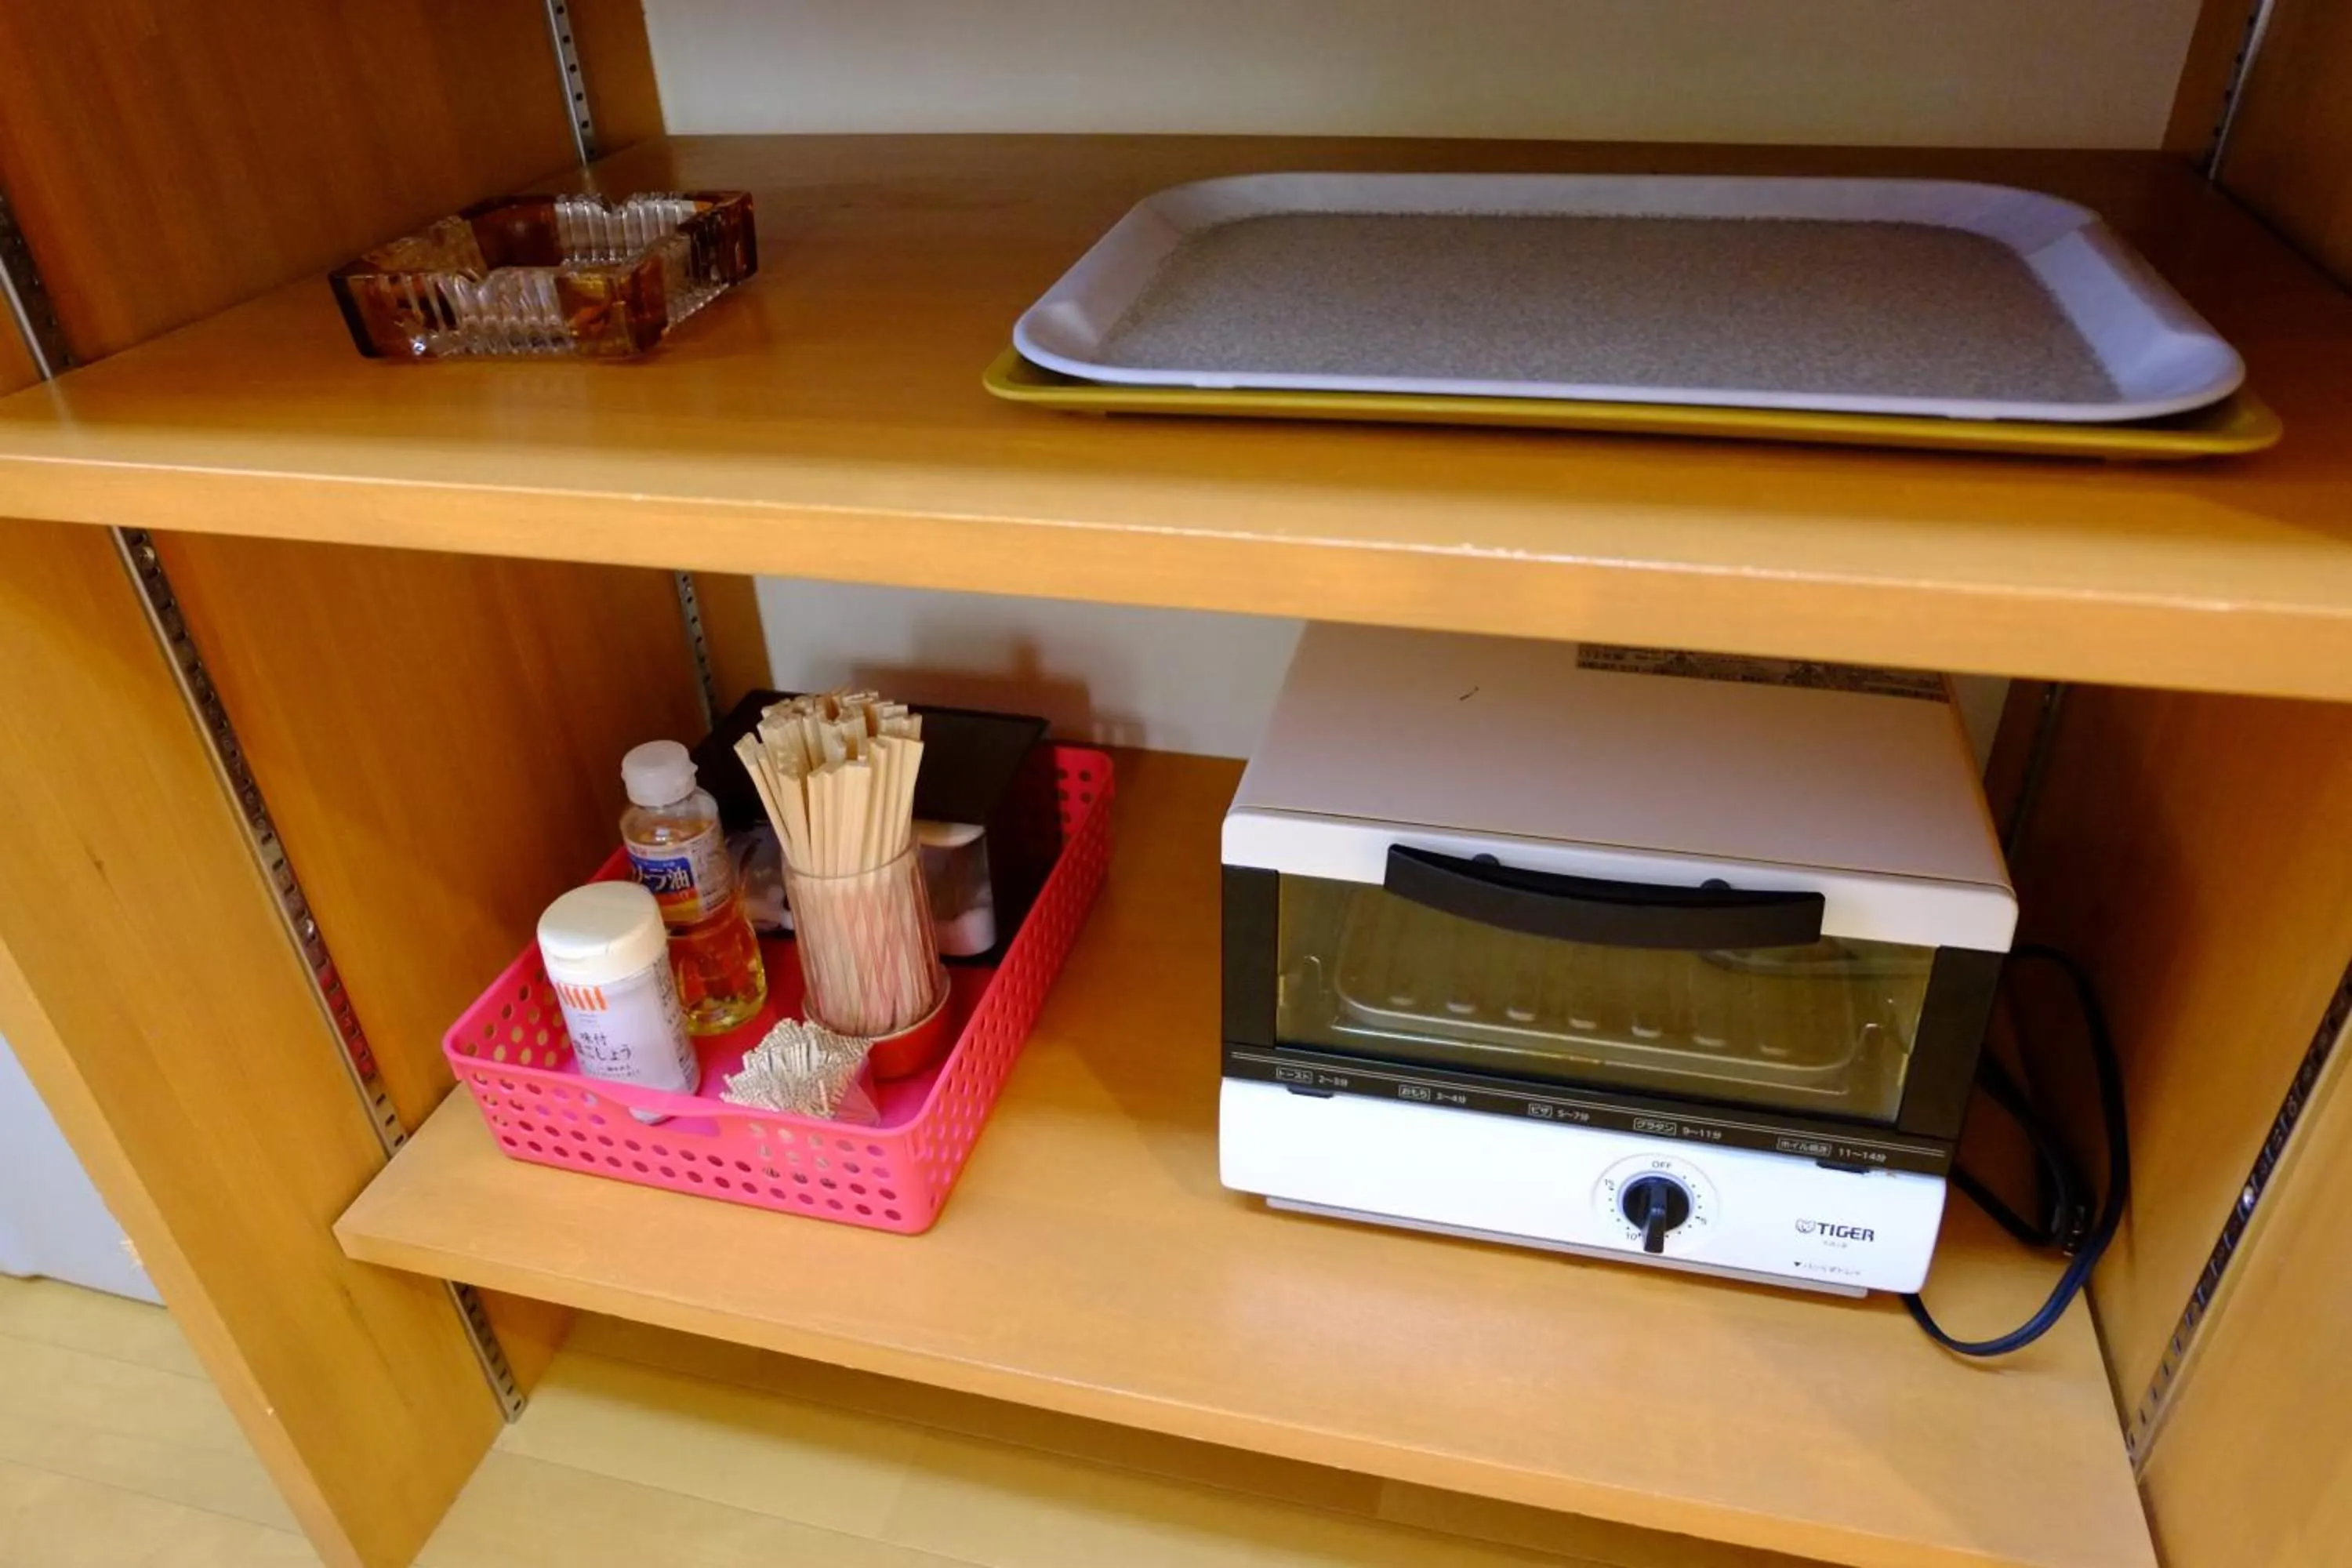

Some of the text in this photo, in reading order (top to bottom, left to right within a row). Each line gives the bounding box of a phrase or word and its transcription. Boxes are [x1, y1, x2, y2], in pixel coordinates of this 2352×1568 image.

[1278, 1069, 1312, 1082] トースト
[1530, 1104, 1552, 1117] ピザ
[1635, 1120, 1675, 1133] グラタン
[1651, 1160, 1672, 1169] OFF
[1626, 1232, 1638, 1240] 10
[1817, 1222, 1875, 1242] TIGER
